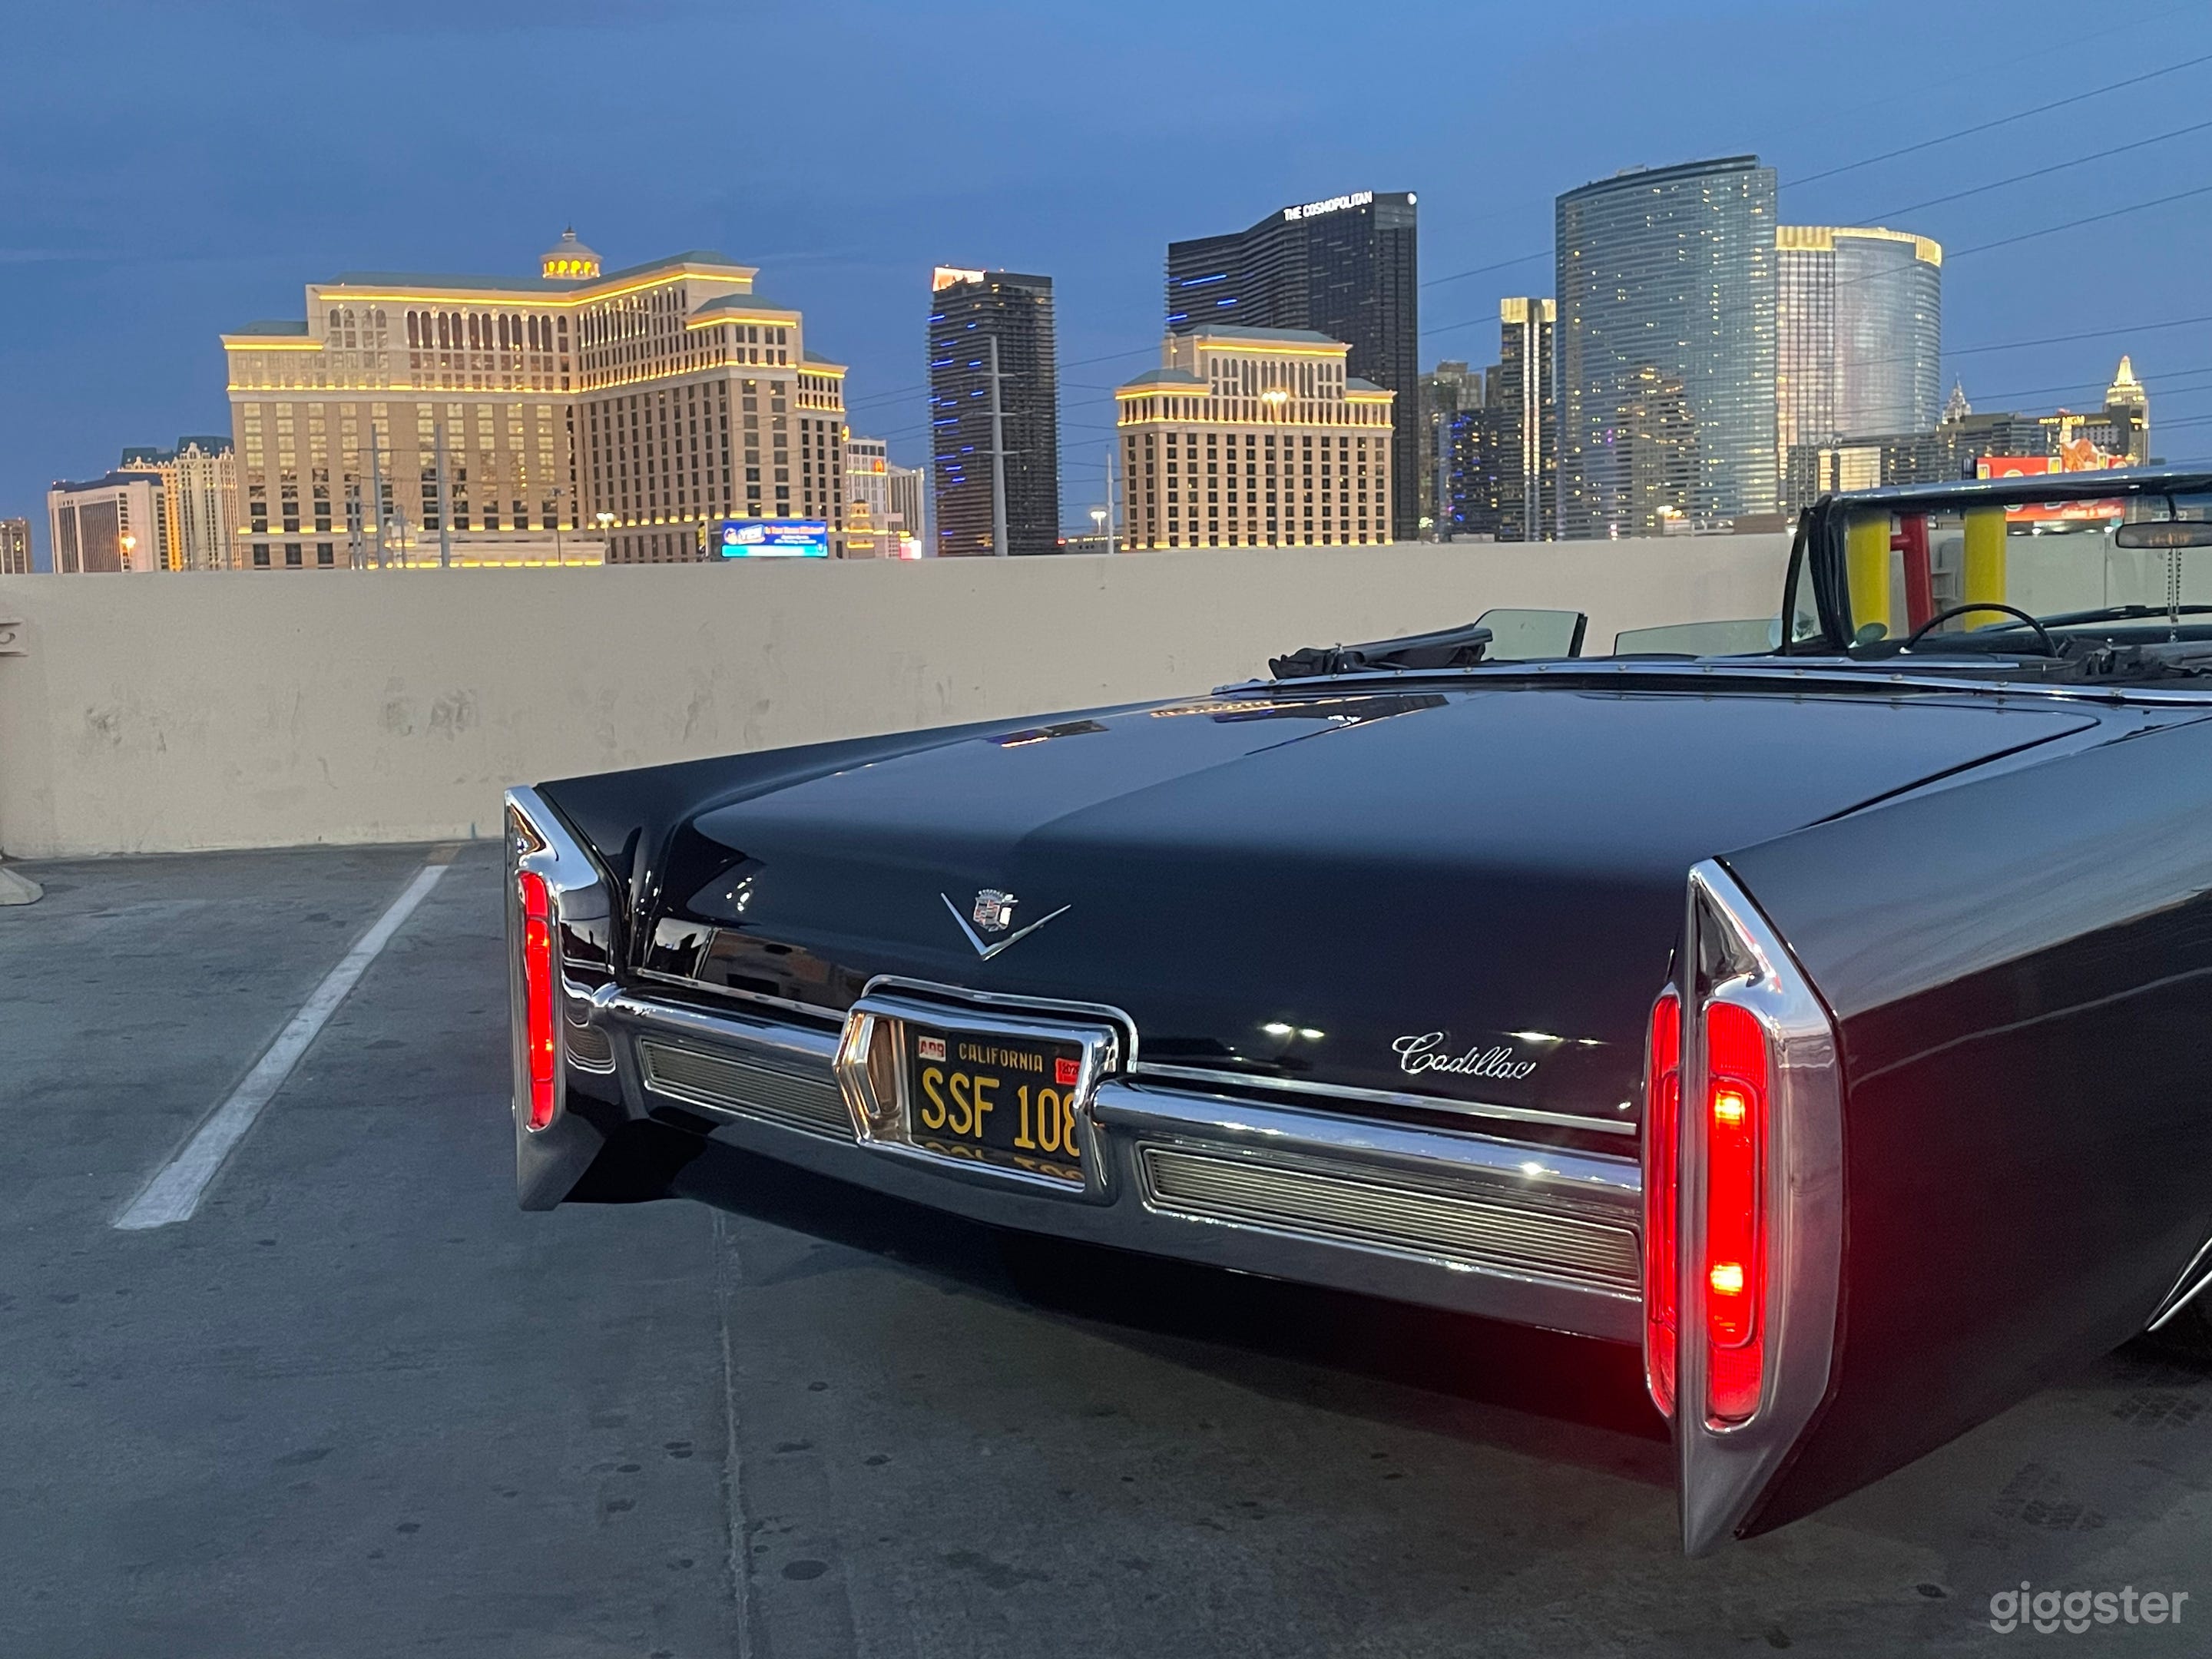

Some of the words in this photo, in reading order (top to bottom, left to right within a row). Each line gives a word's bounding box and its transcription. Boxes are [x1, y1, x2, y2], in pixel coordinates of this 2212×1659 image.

[1283, 205, 1302, 221] THE
[1303, 190, 1373, 217] COSMOPOLITAN
[920, 1040, 945, 1058] APR
[959, 1042, 1043, 1072] CALIFORNIA
[1392, 1031, 1536, 1079] Cadillac
[922, 1067, 1000, 1138] SSF
